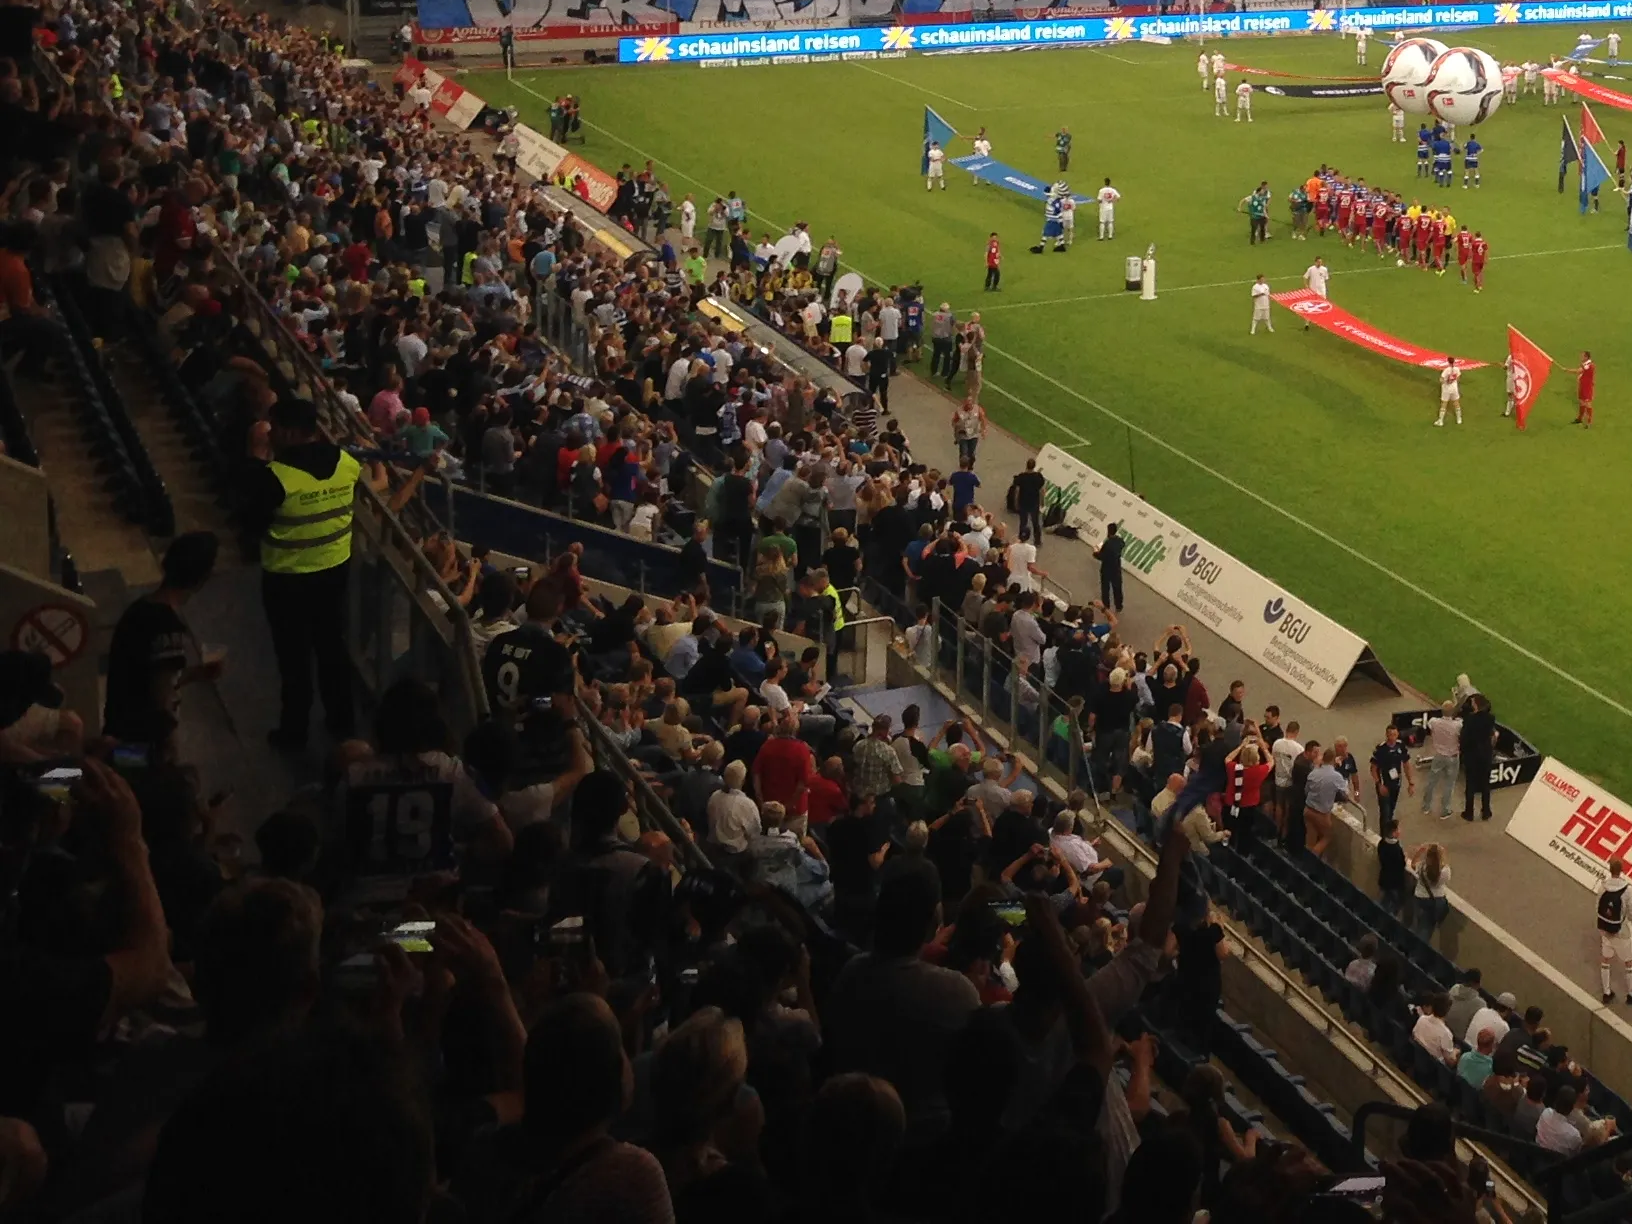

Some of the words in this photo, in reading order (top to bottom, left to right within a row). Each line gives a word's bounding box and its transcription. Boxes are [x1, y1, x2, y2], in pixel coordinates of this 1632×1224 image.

[1341, 7, 1433, 26] schauinsland
[1436, 7, 1479, 23] reisen
[1525, 0, 1610, 20] schauinsland
[920, 25, 1030, 45] schauinsland
[1035, 24, 1085, 39] reisen
[1140, 16, 1240, 35] schauinsland
[1244, 15, 1290, 30] reisen
[678, 33, 800, 57] schauinsland
[805, 33, 860, 50] reisen
[1191, 555, 1222, 585] BGU
[1278, 612, 1312, 645] BGU
[1411, 711, 1431, 730] sk
[1490, 762, 1522, 785] sky
[1542, 771, 1581, 799] HELLWEG
